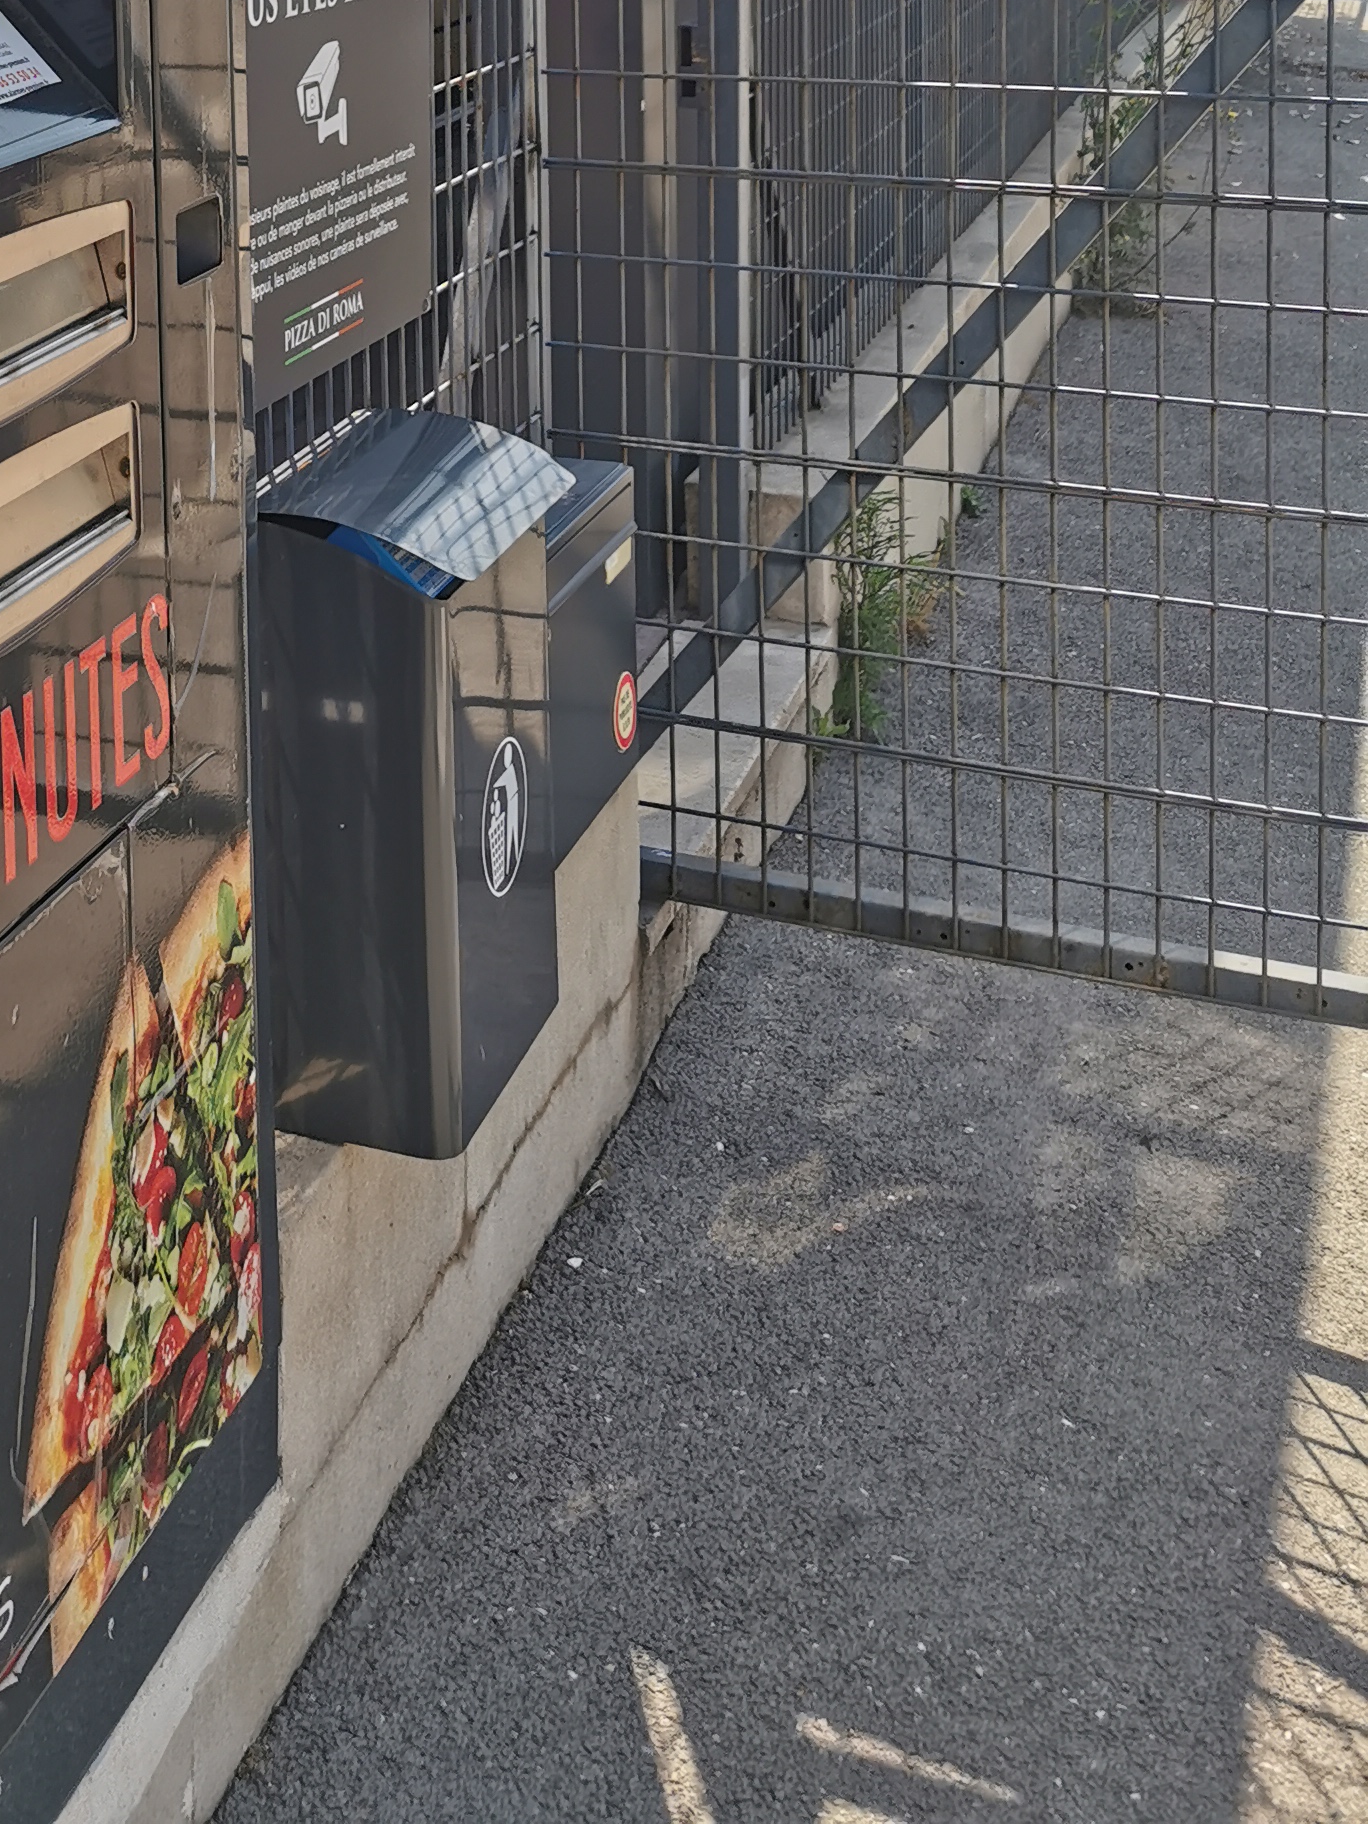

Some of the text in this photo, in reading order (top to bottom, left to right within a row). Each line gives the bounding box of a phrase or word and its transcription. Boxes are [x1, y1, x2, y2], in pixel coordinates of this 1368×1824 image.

[257, 233, 267, 247] ou
[268, 225, 278, 242] de
[278, 217, 304, 238] manger
[304, 205, 328, 226] devant
[327, 200, 334, 215] la
[358, 189, 367, 202] ou
[367, 182, 373, 198] le
[272, 195, 299, 222] plaintes
[300, 187, 309, 204] du
[341, 170, 346, 187] il
[347, 170, 357, 185] est
[356, 153, 395, 180] formellement
[395, 142, 416, 164] interdit
[259, 245, 293, 271] nuisances
[293, 233, 321, 256] sonores,
[320, 226, 333, 242] une
[334, 217, 356, 242] plainte
[355, 210, 369, 226] sera
[369, 196, 395, 221] déposée
[273, 271, 284, 288] les
[284, 261, 307, 282] vidéos
[307, 253, 317, 272] de
[317, 251, 330, 267] nos
[329, 238, 355, 261] caméras
[355, 231, 364, 248] de
[284, 291, 364, 352] PIZZA DI ROMA
